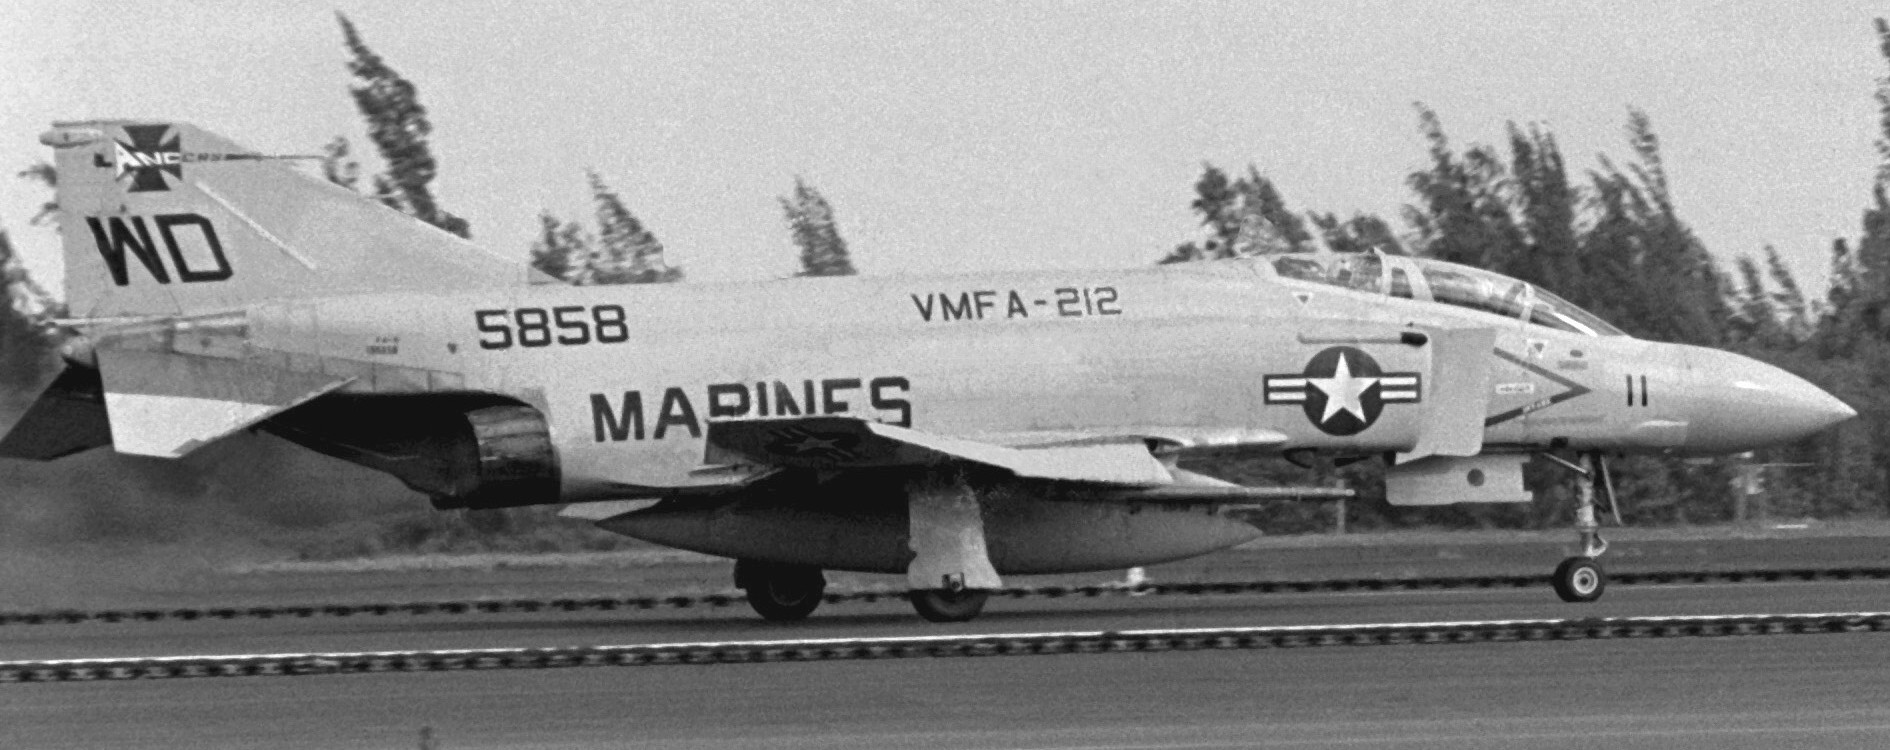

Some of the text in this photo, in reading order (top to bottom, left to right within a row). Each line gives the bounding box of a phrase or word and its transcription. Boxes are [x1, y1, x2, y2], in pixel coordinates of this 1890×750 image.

[86, 213, 233, 286] WD
[911, 286, 1123, 322] VMFA-212
[475, 305, 629, 350] 5858
[590, 377, 912, 442] MARINES
[1626, 375, 1649, 408] 11
